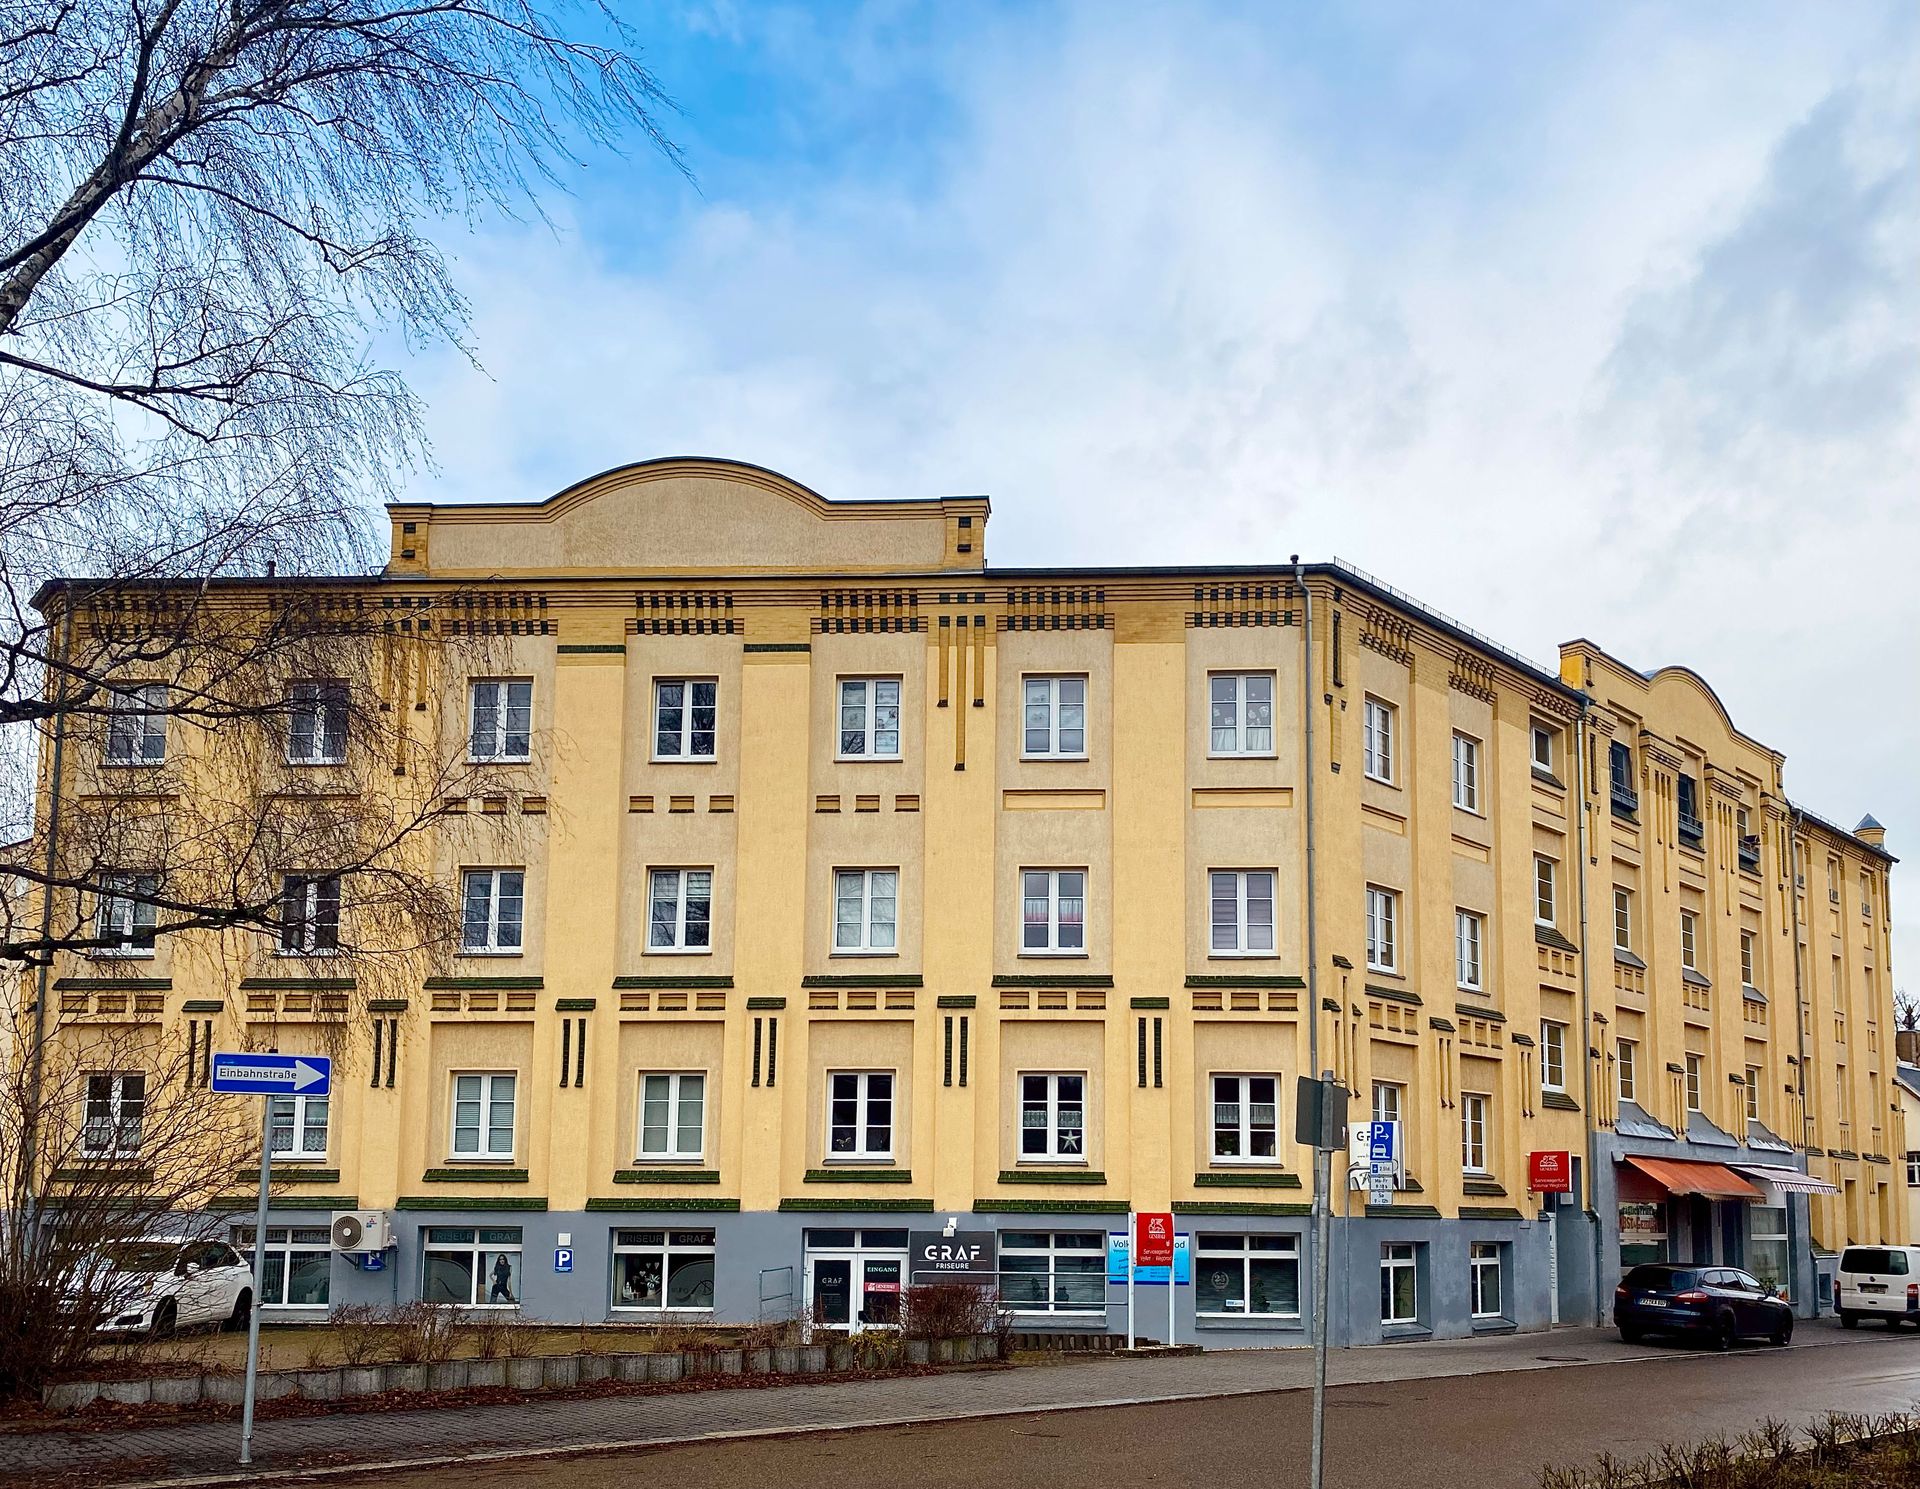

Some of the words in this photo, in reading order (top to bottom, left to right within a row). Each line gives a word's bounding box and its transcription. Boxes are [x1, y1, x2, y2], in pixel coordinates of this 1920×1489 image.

[219, 1068, 297, 1079] Einbahnstraße
[1374, 1124, 1384, 1139] P
[489, 1231, 518, 1241] GRAF
[678, 1234, 707, 1243] GRAF
[924, 1245, 981, 1260] GRAF
[558, 1251, 571, 1266] P
[935, 1262, 970, 1270] FRISEURE
